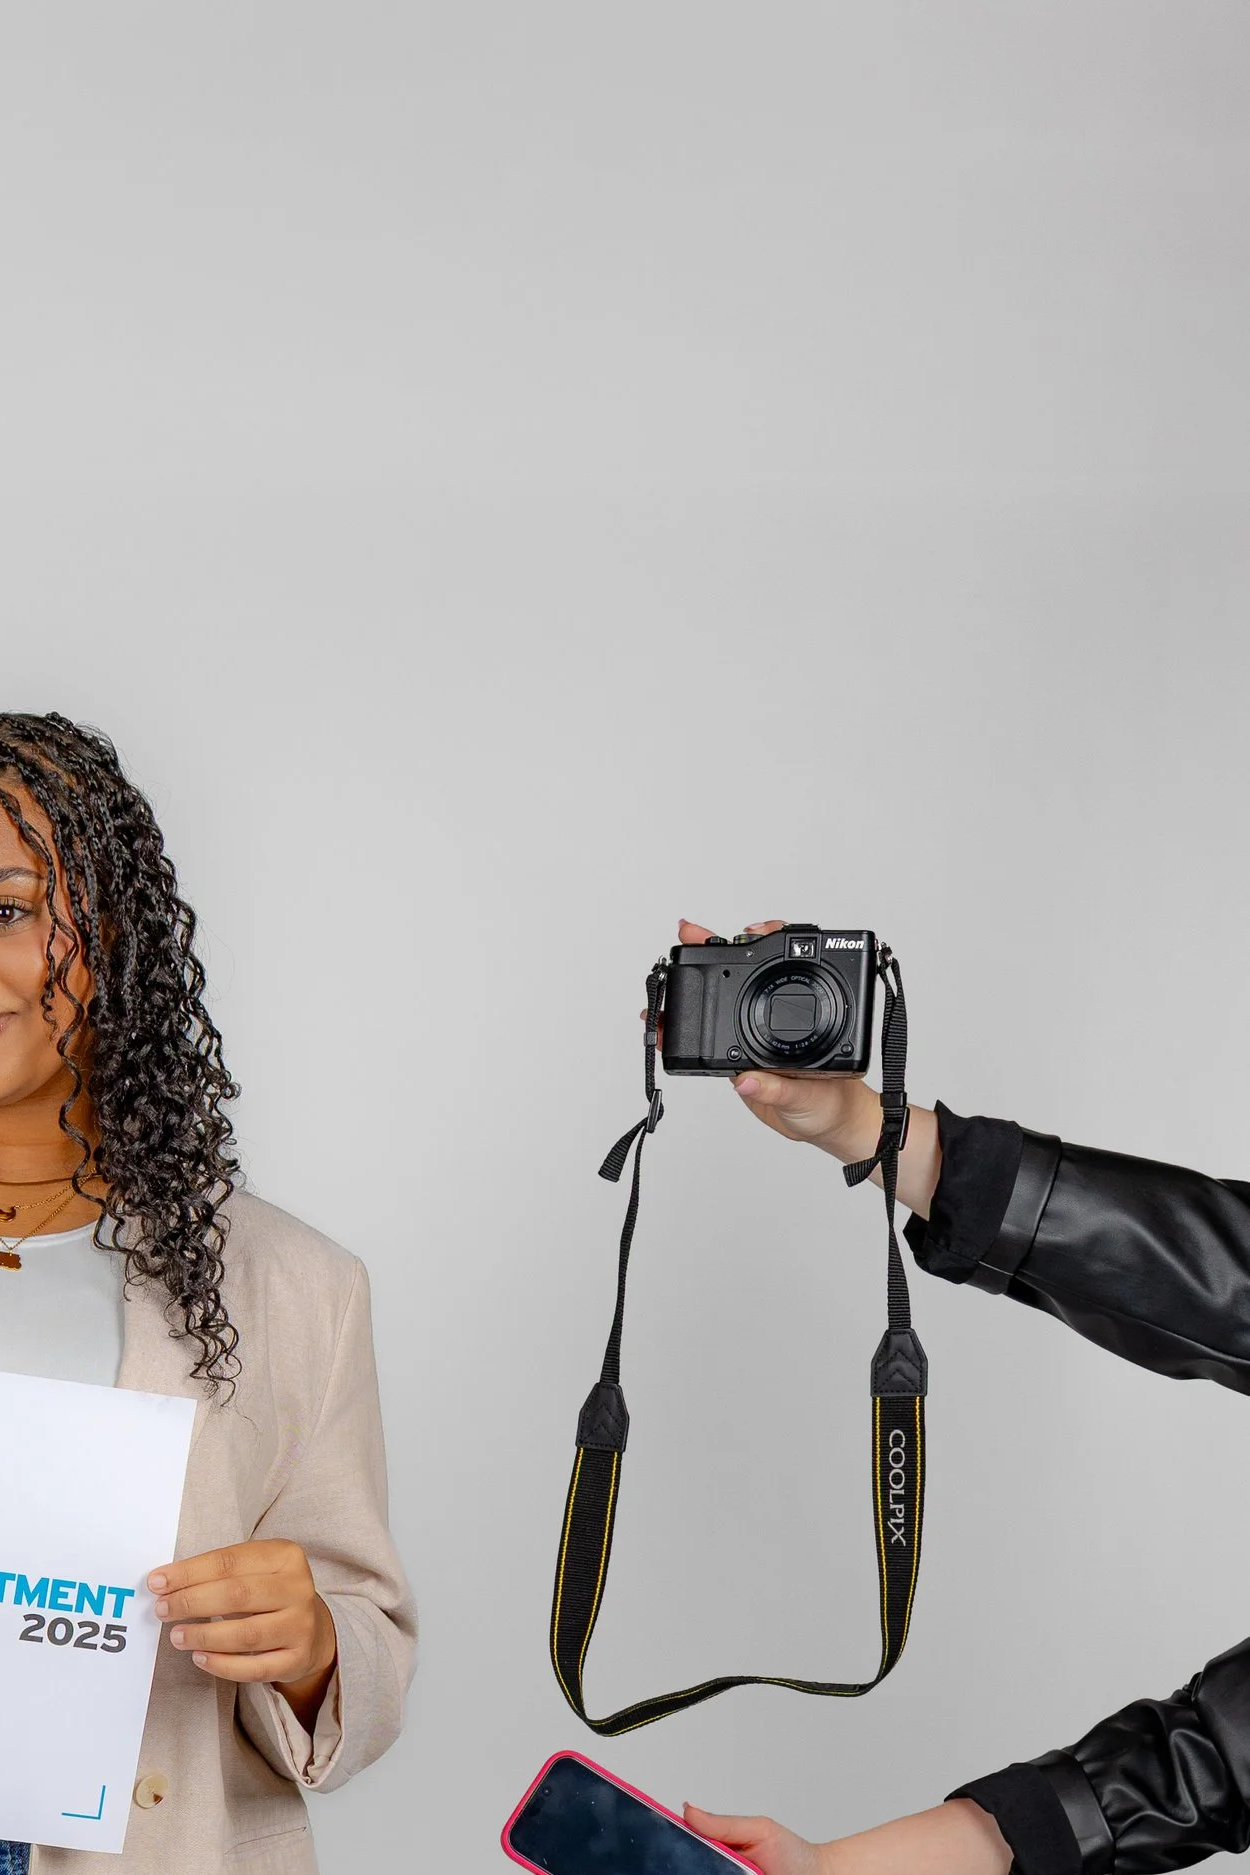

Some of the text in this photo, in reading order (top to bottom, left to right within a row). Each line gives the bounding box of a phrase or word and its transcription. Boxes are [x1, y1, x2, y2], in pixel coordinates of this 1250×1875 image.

[825, 938, 865, 949] Nikon
[888, 1429, 906, 1547] COOLPIX
[18, 1613, 129, 1654] 2025
